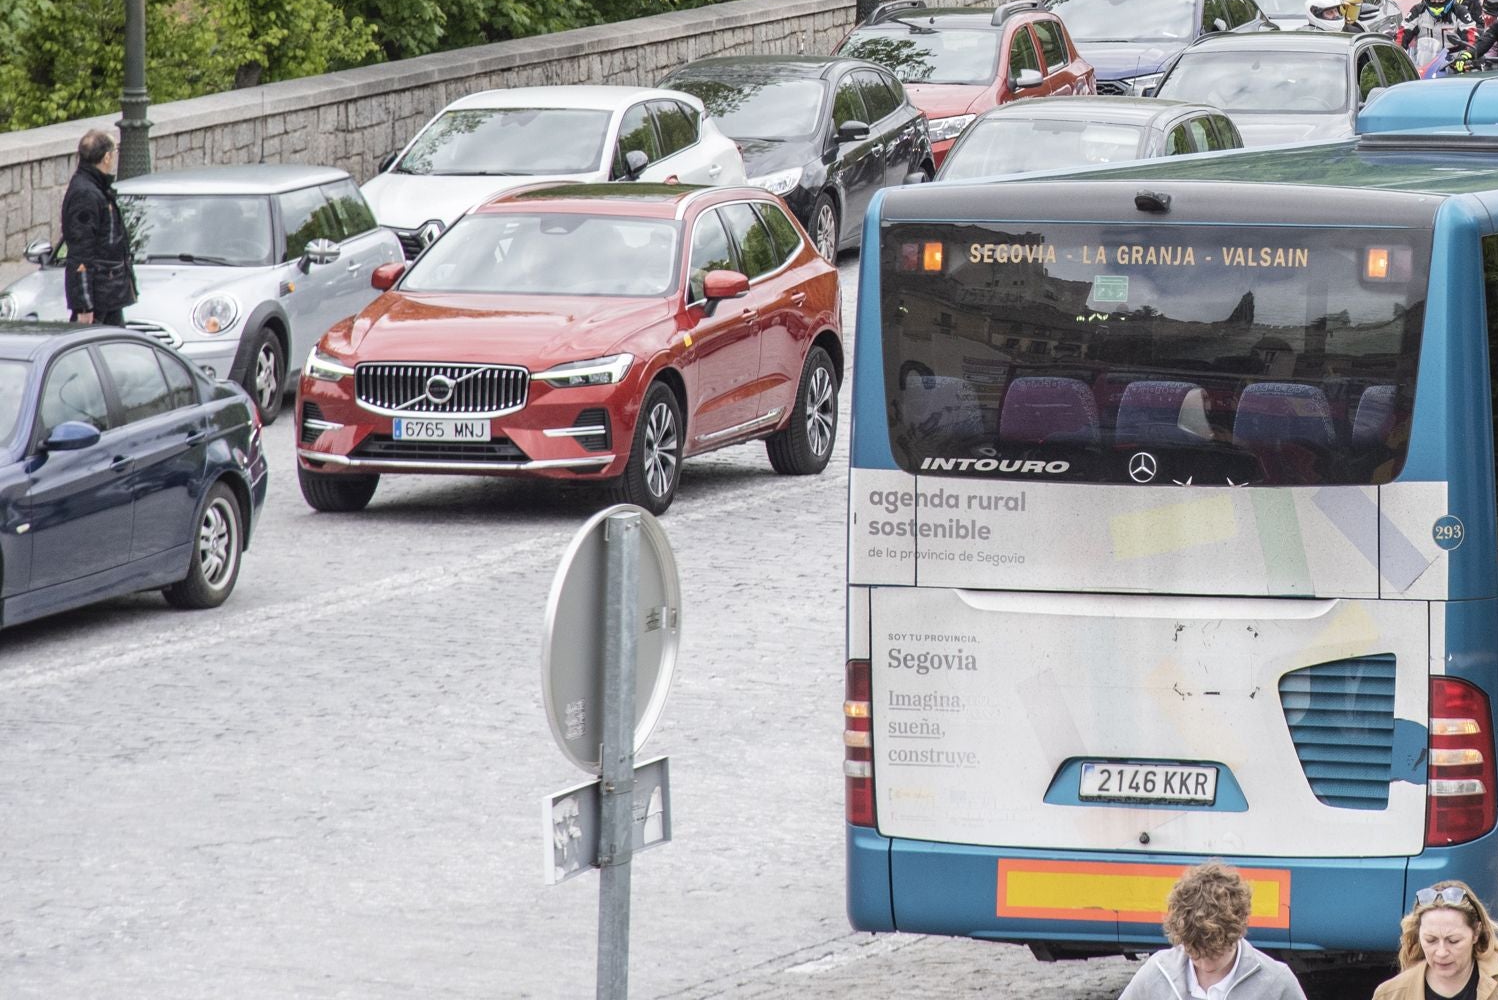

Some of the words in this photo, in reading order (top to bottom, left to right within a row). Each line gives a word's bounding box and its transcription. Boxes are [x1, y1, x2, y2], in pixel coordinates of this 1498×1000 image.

[970, 243, 1056, 264] SEGOVIA
[1082, 245, 1107, 265] LA
[1117, 245, 1196, 266] GRANJA
[1222, 247, 1308, 267] VALSAIN
[405, 421, 445, 438] 6765
[454, 422, 484, 438] MNJ
[920, 457, 1070, 473] INTOURO
[869, 488, 960, 513] agenda
[967, 491, 1026, 512] rural
[868, 518, 992, 541] sostenible
[1435, 524, 1462, 539] 293
[868, 547, 883, 558] de
[886, 547, 897, 559] la
[900, 549, 955, 564] provincia
[958, 550, 973, 562] de
[977, 551, 1026, 567] Segovia
[888, 633, 907, 641] SOY
[909, 633, 922, 641] TU
[888, 648, 978, 675] Segovia
[888, 690, 966, 712] Imagina,
[888, 718, 946, 738] sueña,
[888, 748, 980, 768] construye.
[1098, 769, 1157, 793] 2146
[1163, 771, 1208, 796] KKR
